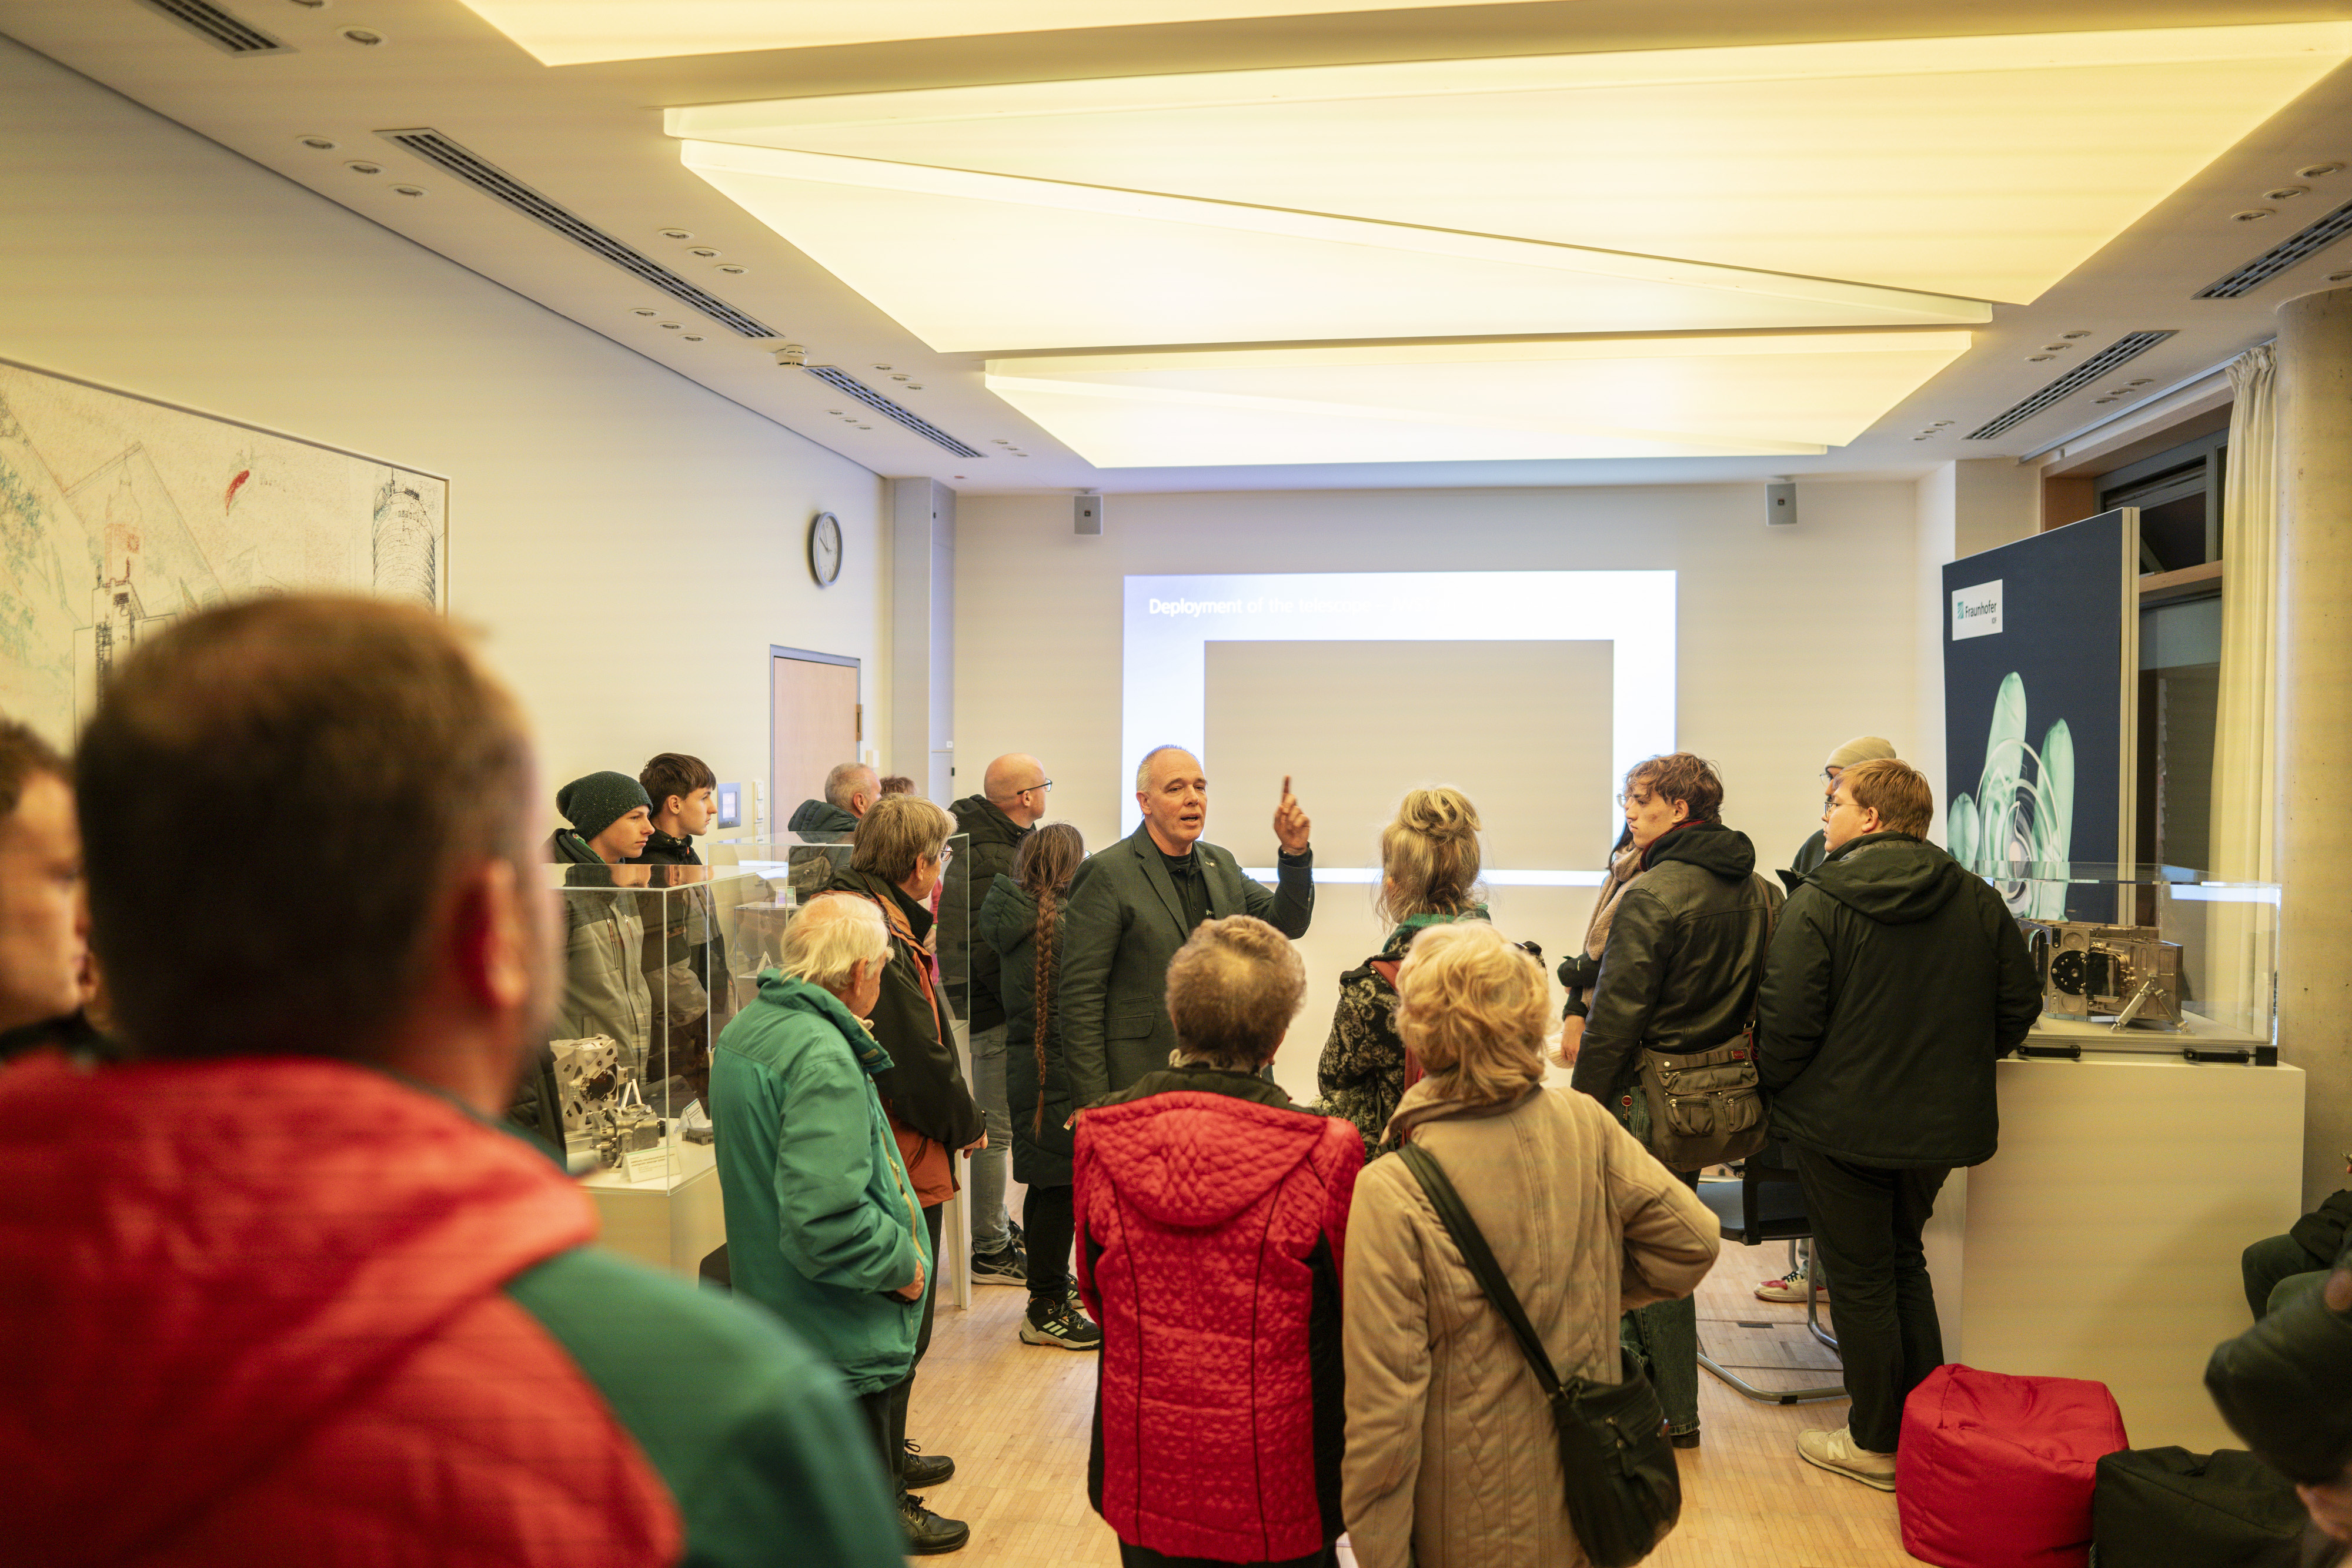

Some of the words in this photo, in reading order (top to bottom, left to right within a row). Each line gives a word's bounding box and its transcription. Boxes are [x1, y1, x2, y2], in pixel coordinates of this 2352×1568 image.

[1148, 598, 1242, 617] Deployment
[1246, 597, 1264, 614] of
[1268, 597, 1294, 613] the
[1298, 597, 1371, 616] telescope
[1965, 600, 1997, 618] Fraunhofer
[1827, 1439, 1847, 1461] N
